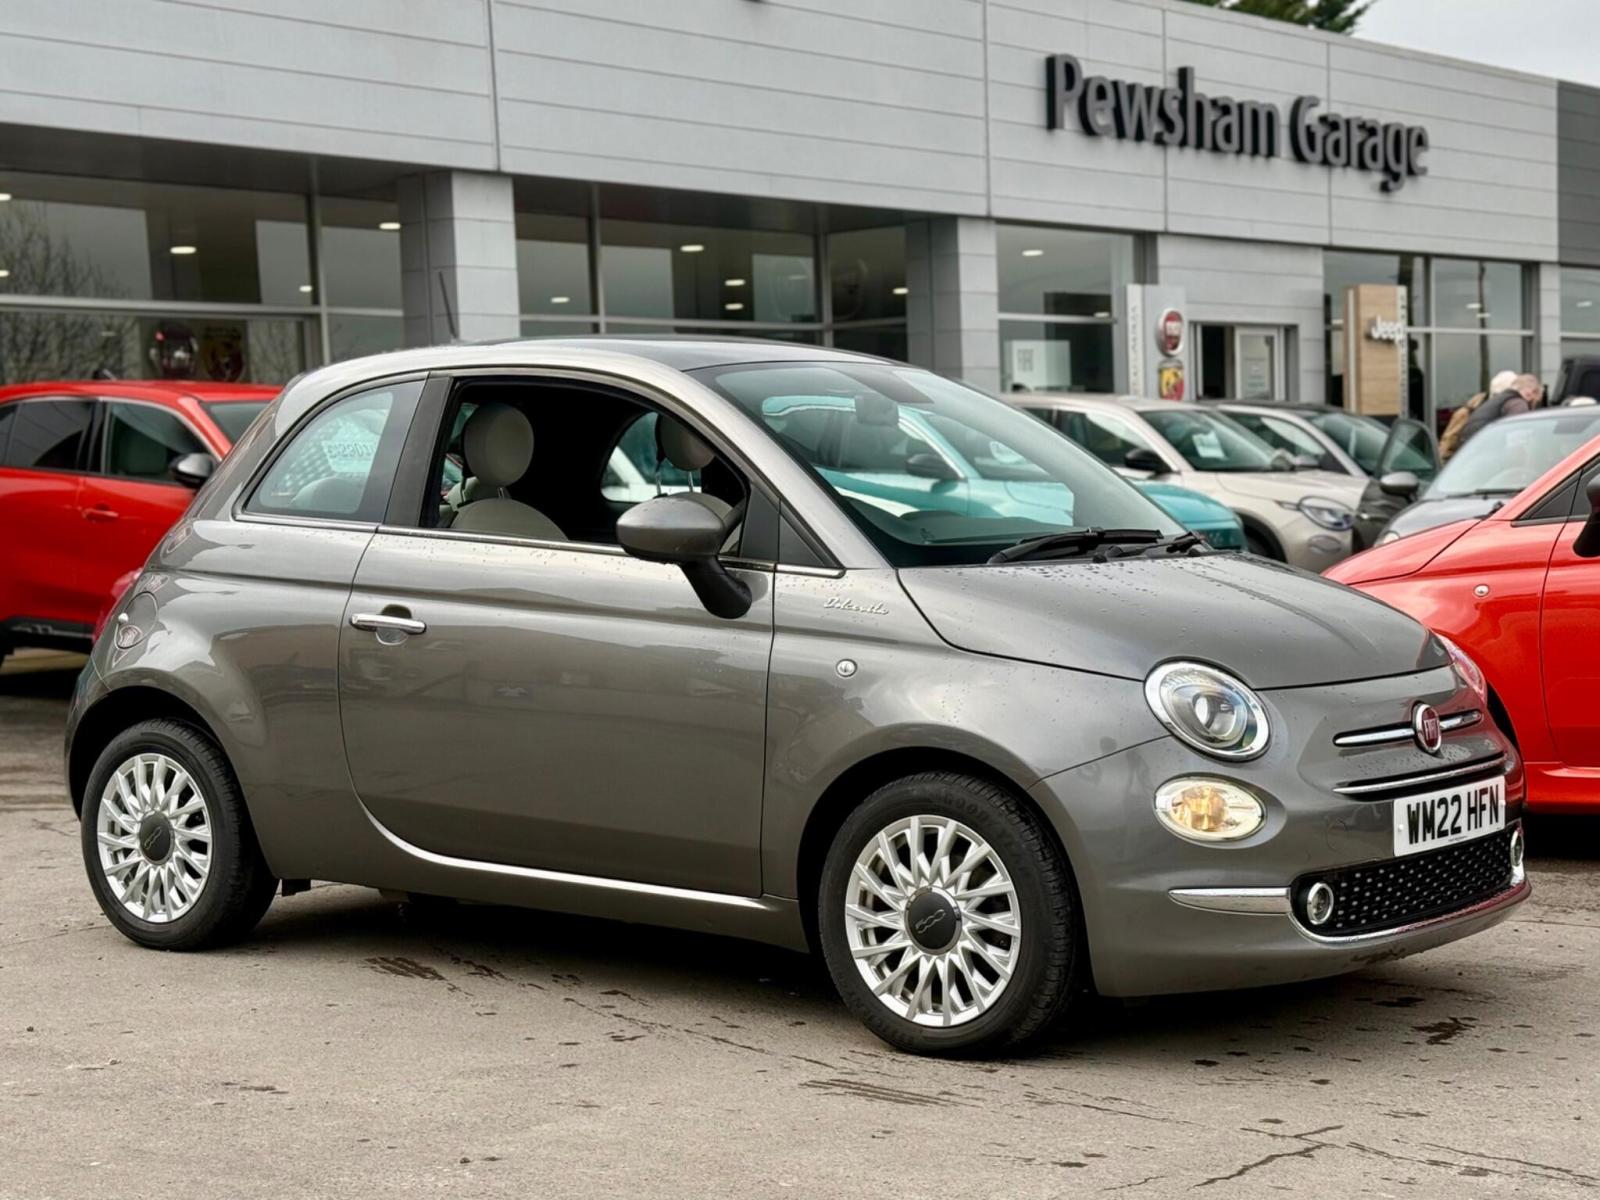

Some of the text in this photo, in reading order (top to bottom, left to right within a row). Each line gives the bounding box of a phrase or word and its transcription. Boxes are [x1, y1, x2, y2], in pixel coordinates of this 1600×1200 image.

[1046, 53, 1429, 193] Pewsham Garage
[1370, 315, 1405, 345] Jeep
[1407, 784, 1499, 845] WM22 HFN
